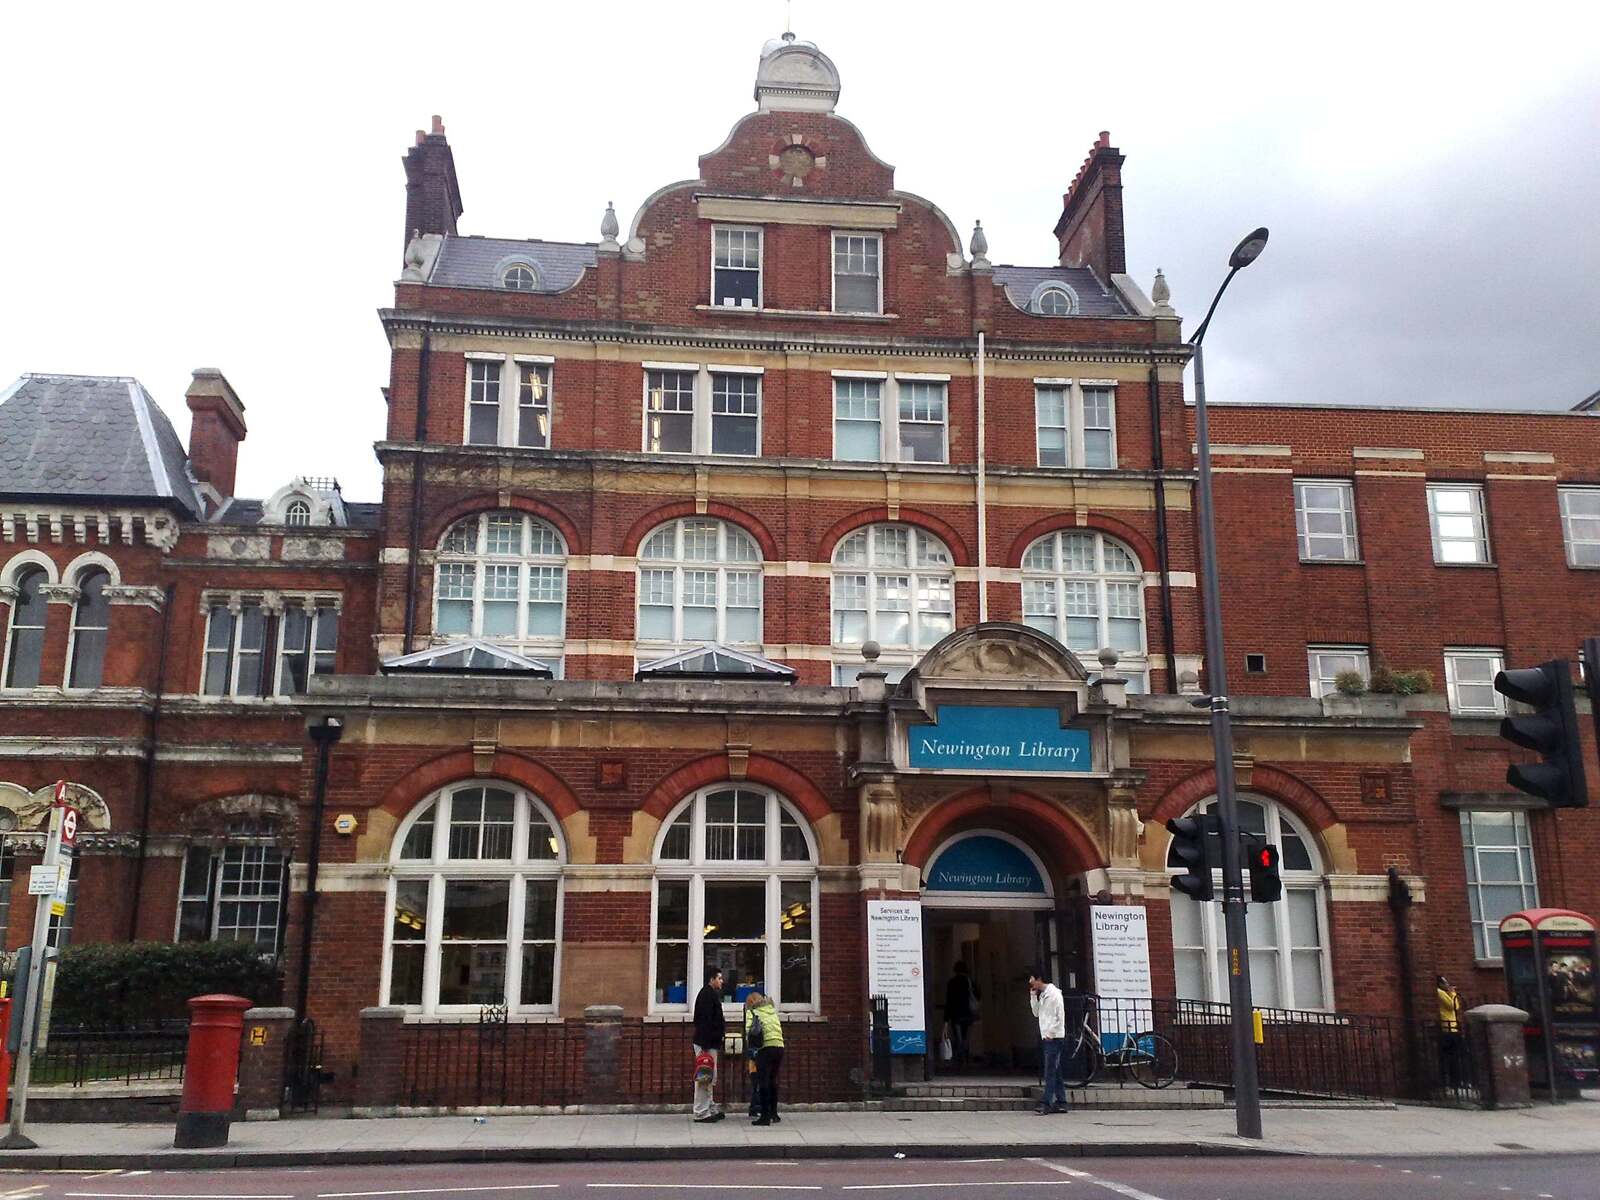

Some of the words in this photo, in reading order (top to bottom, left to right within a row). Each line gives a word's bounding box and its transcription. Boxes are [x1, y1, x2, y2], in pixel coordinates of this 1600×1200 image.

[920, 739, 1011, 761] Newington
[1019, 741, 1080, 762] Library
[59, 784, 66, 801] A
[939, 871, 992, 885] Newington
[996, 872, 1032, 887] Library
[900, 914, 920, 923] Library
[1095, 911, 1145, 922] Newington
[1095, 922, 1129, 933] Library
